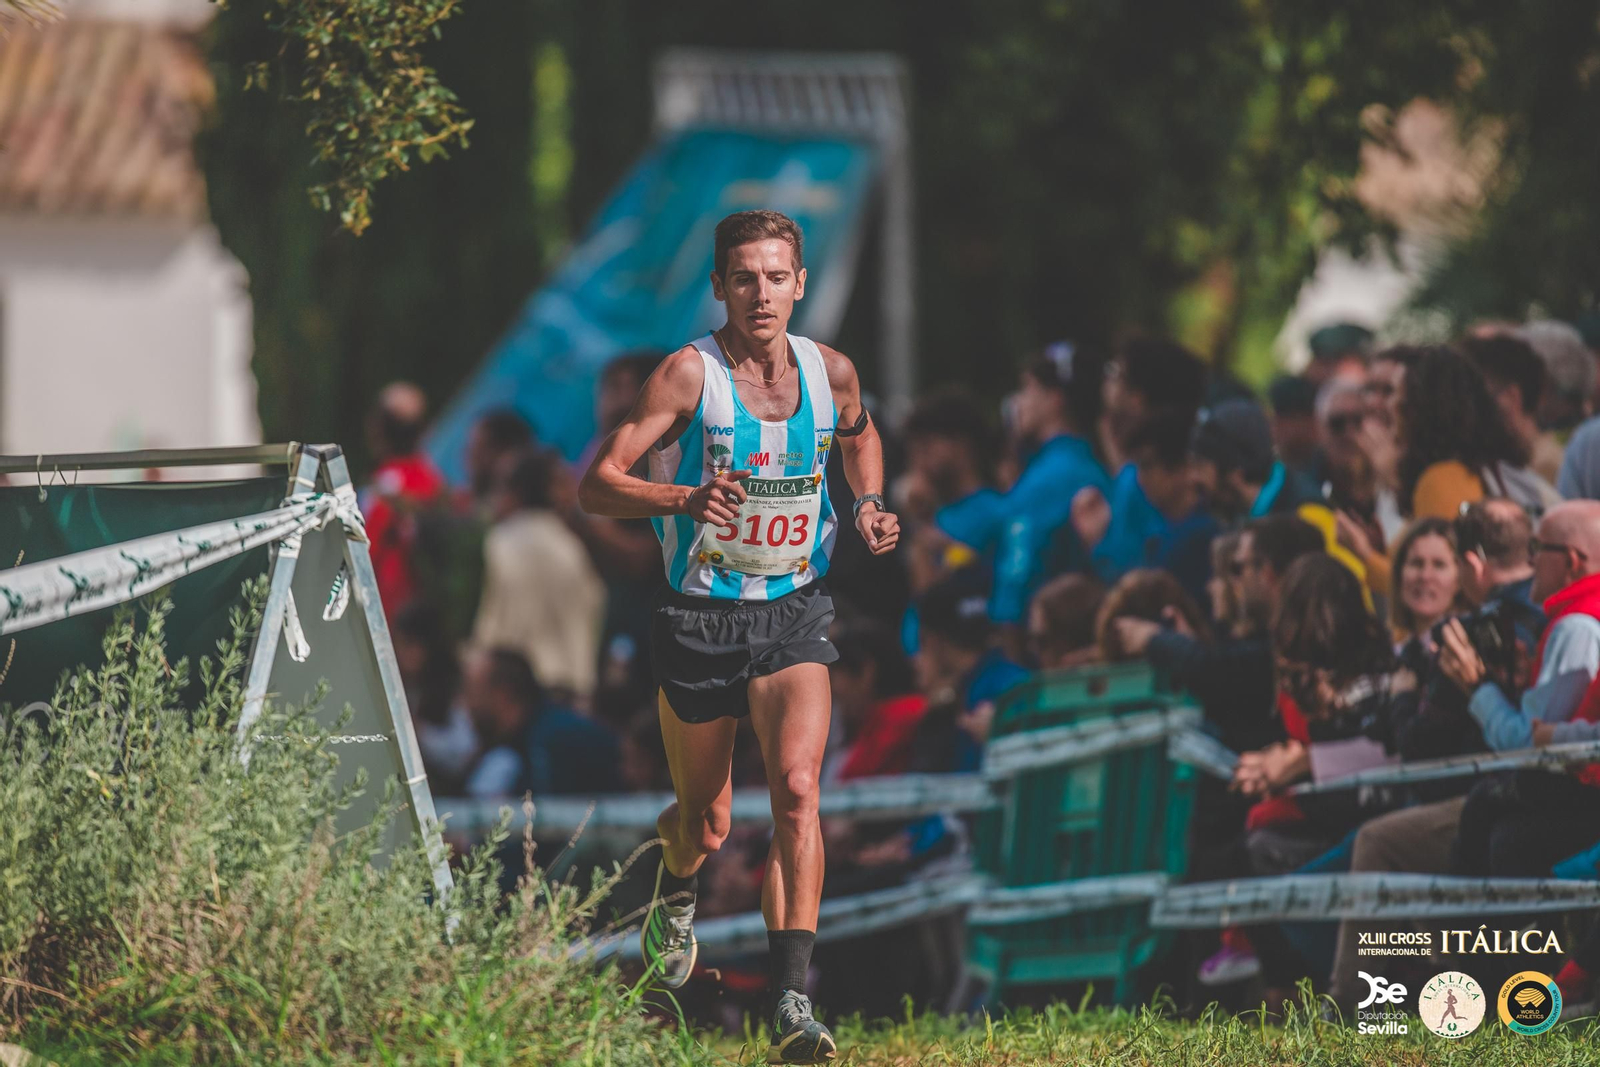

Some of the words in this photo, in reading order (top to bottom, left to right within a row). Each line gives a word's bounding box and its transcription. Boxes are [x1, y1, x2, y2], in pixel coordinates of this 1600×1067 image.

[705, 424, 734, 436] vive
[778, 451, 803, 459] metro
[747, 481, 797, 495] ITÁLICA
[715, 513, 809, 548] 5103
